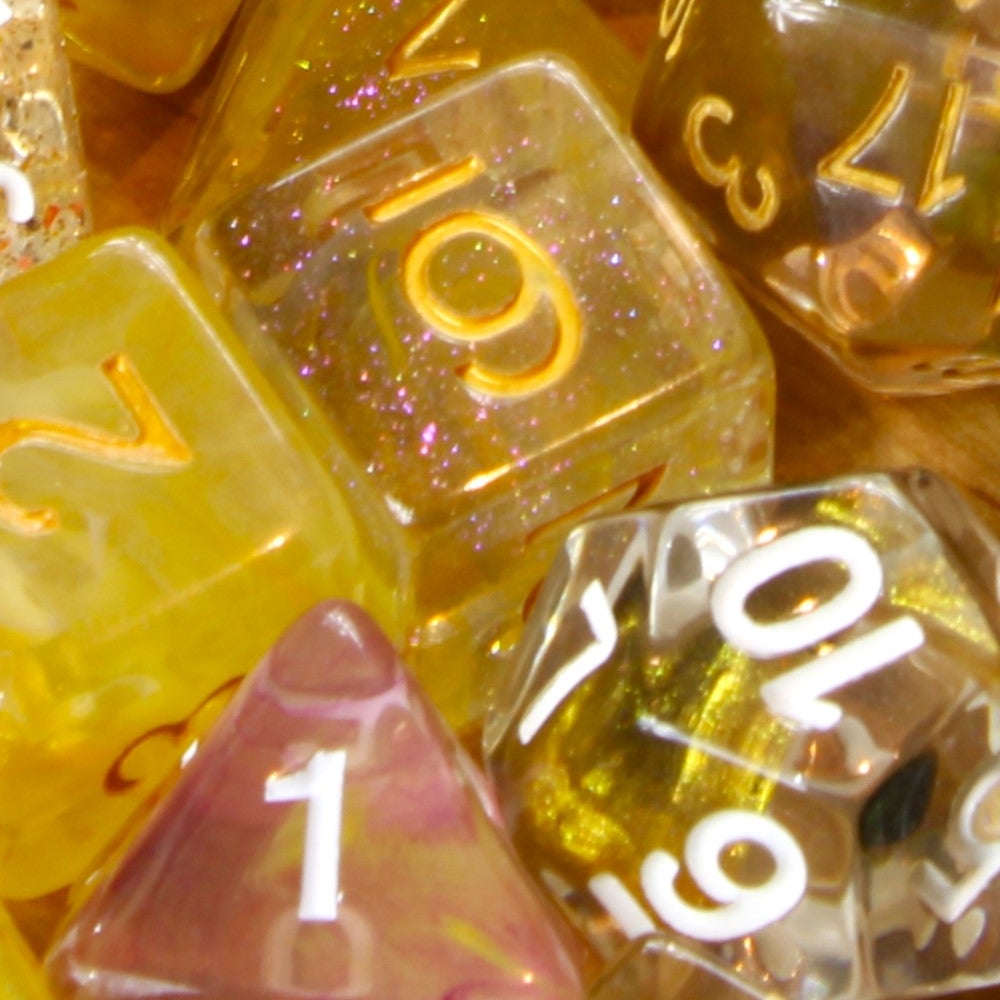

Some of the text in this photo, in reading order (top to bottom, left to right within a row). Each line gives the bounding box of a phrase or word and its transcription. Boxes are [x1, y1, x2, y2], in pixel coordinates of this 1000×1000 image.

[683, 96, 781, 231] 3
[710, 525, 926, 732] 10
[264, 747, 348, 922] 1
